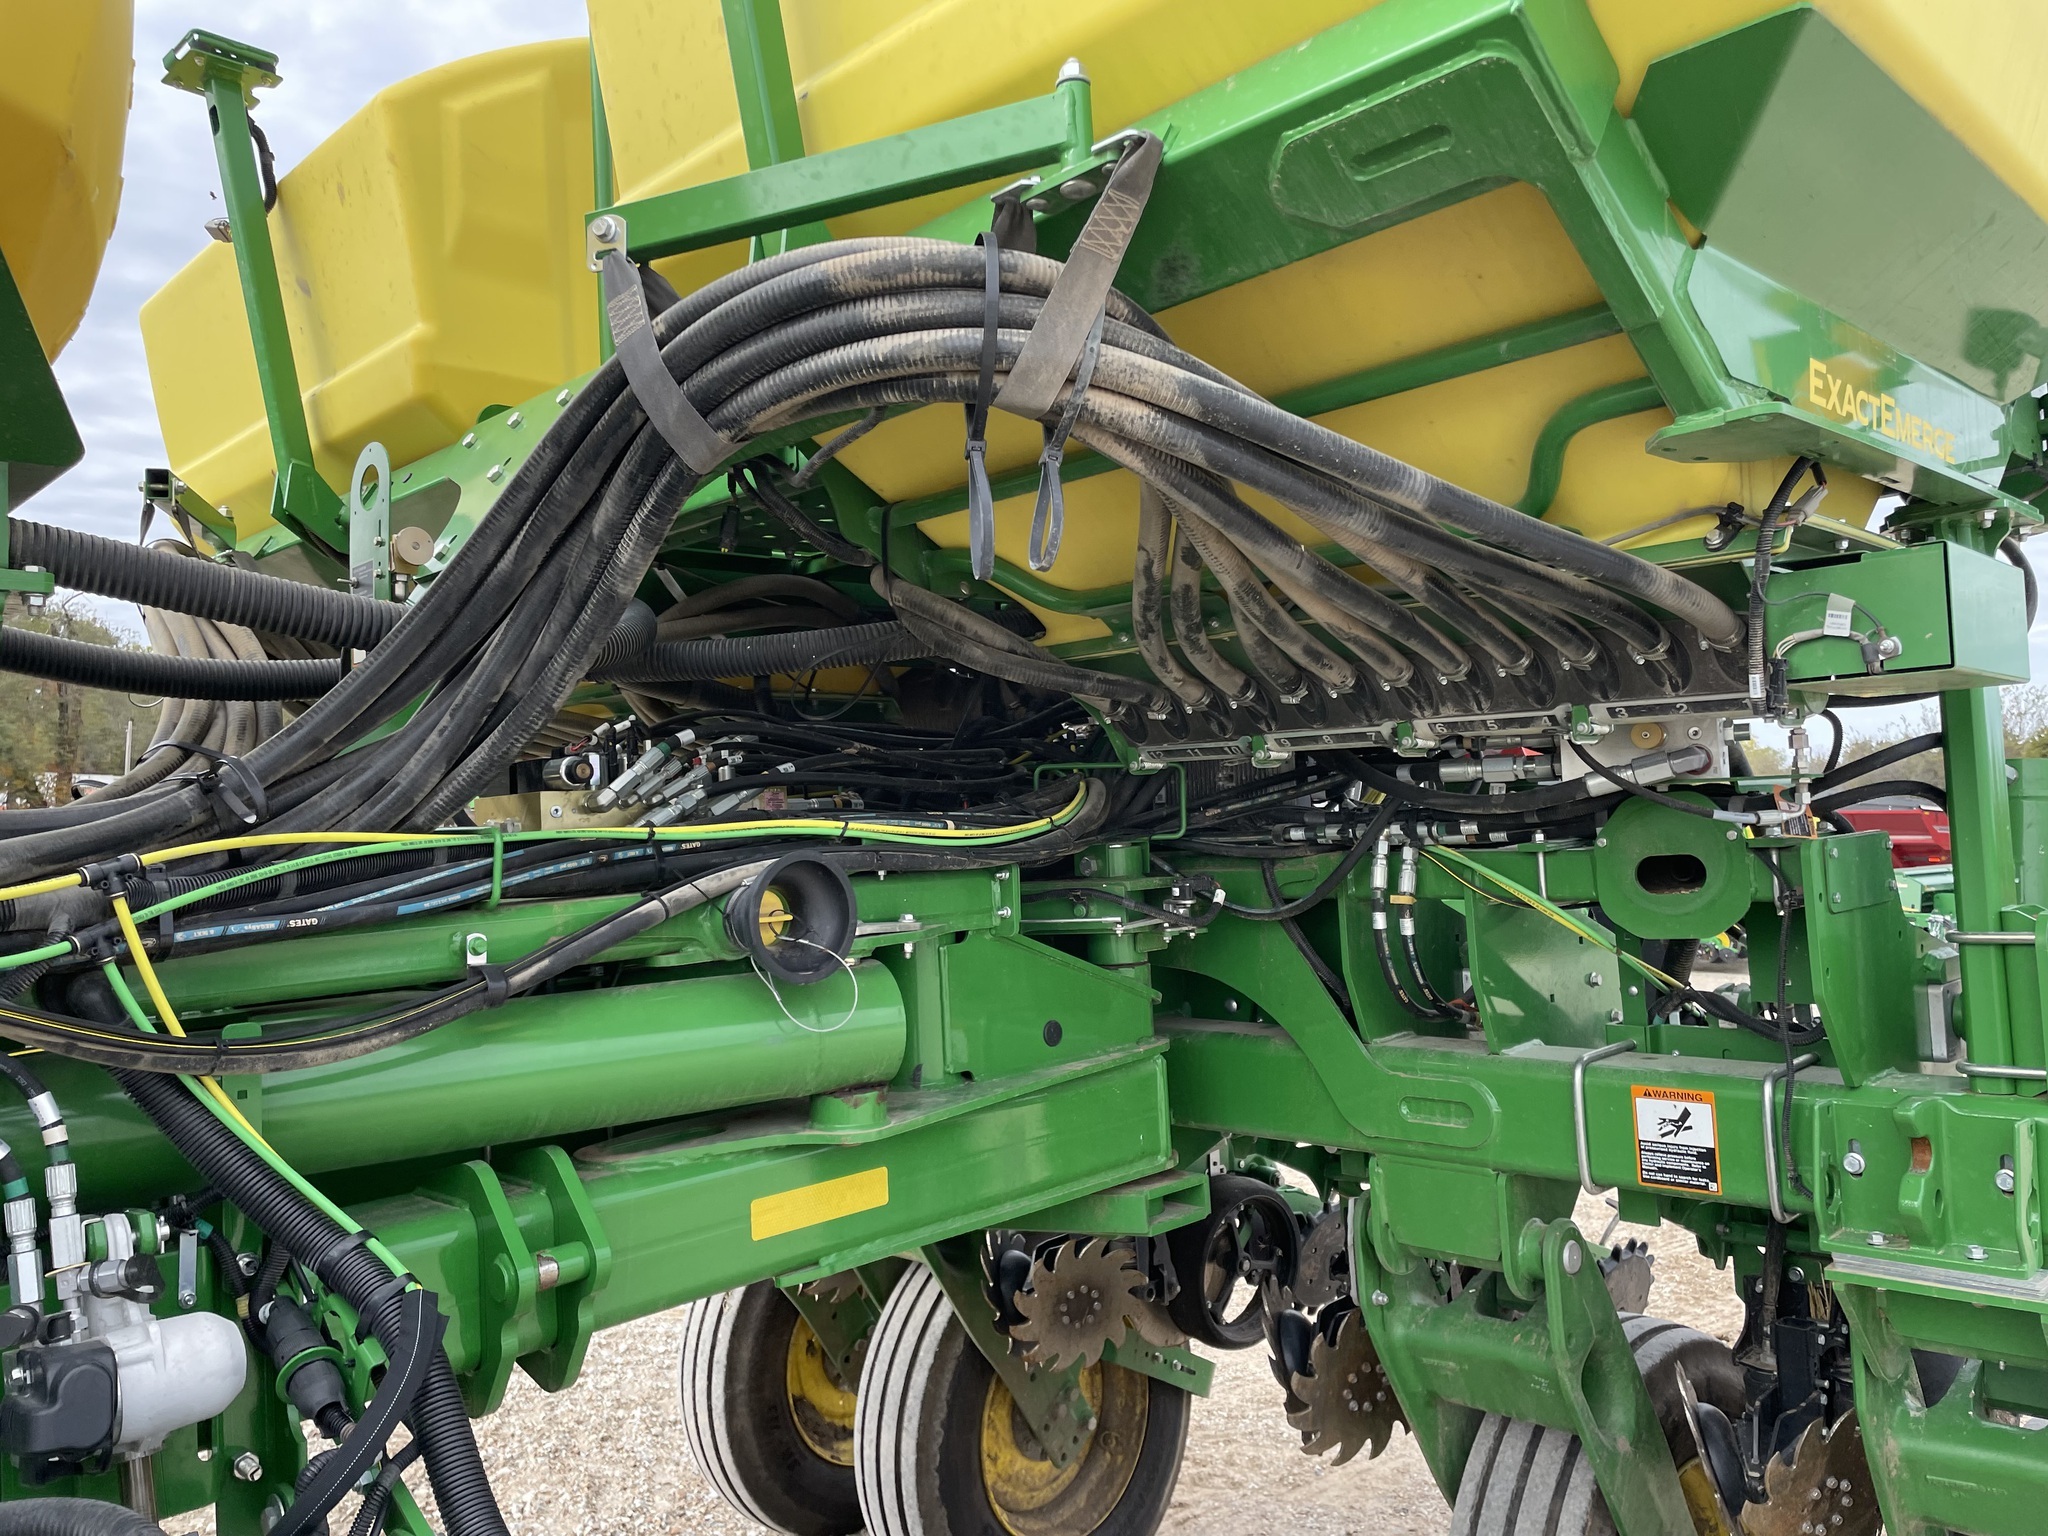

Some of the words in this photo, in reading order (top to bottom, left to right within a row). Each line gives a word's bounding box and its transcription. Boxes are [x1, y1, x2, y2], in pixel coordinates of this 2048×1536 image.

[1615, 707, 1628, 718] 3
[1676, 703, 1690, 714] 2
[1435, 723, 1447, 734] 6
[1486, 720, 1498, 731] 5
[1541, 716, 1552, 727] 4
[1280, 738, 1291, 747] 9
[1322, 735, 1334, 744] 8
[1366, 732, 1376, 741] 7
[1150, 751, 1164, 760] 12
[1187, 748, 1202, 757] 11
[1224, 746, 1241, 755] 10
[289, 918, 318, 928] GATES
[1652, 1089, 1703, 1102] WARNING
